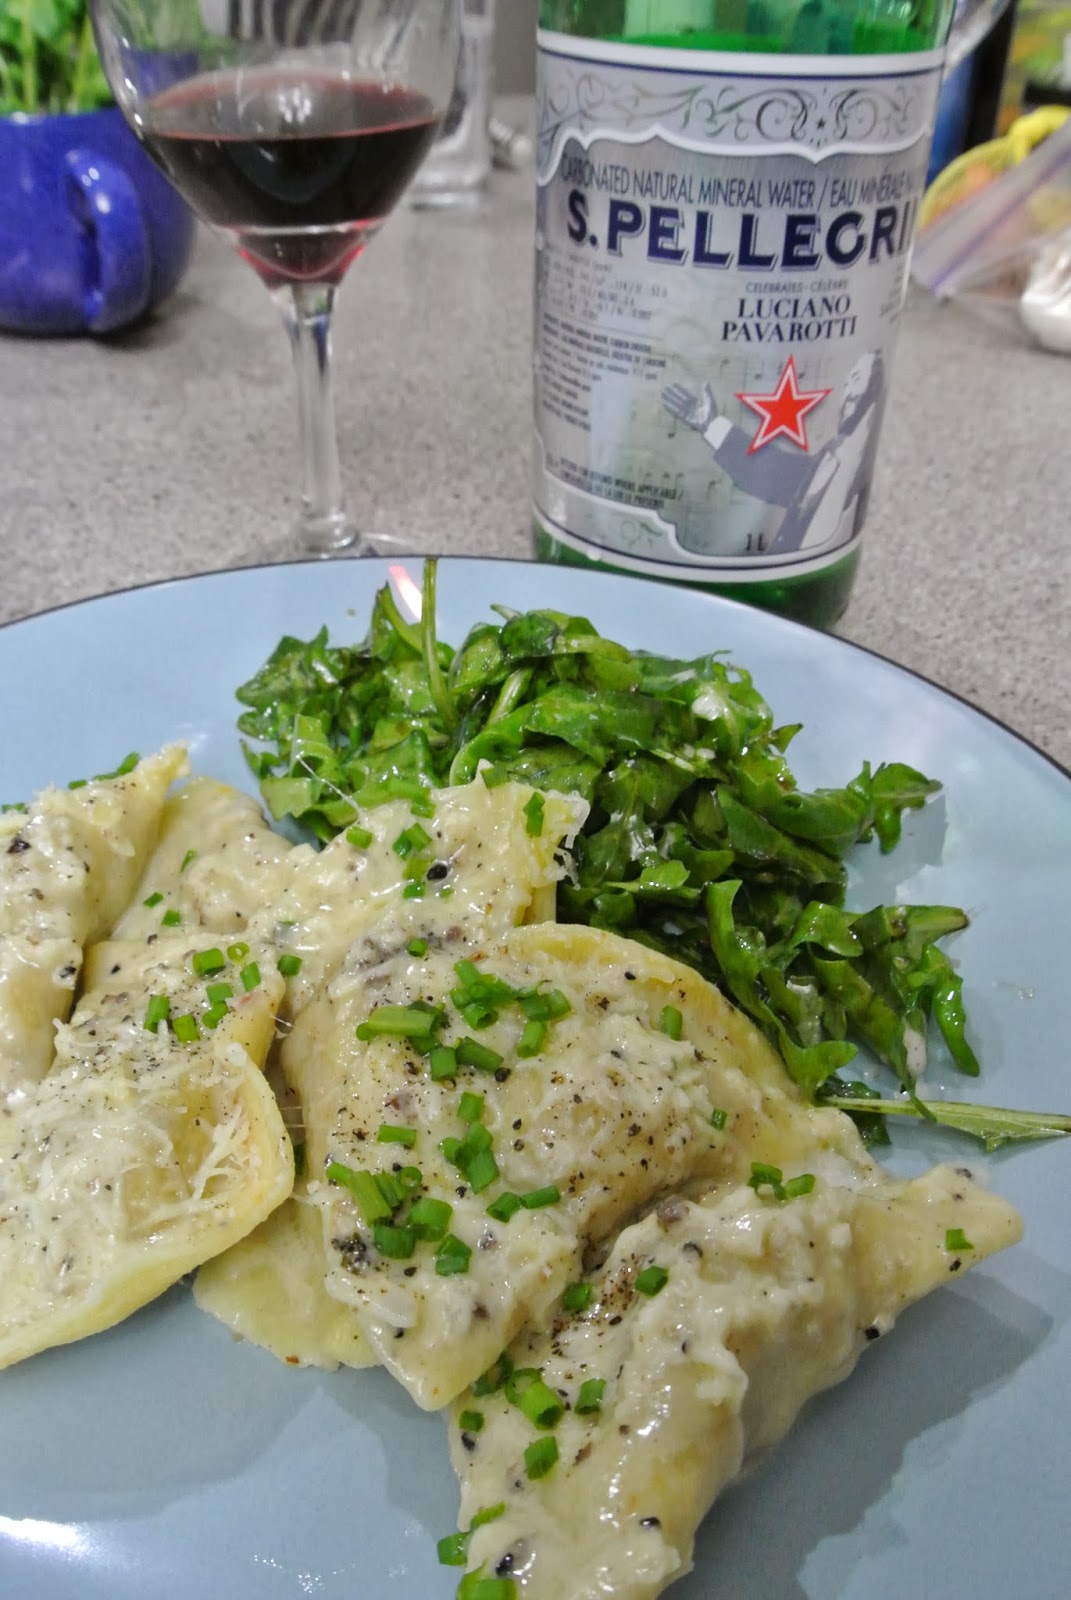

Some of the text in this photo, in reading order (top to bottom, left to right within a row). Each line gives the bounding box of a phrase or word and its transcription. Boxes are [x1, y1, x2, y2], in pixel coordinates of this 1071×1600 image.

[634, 169, 693, 203] NATURAL
[697, 176, 762, 208] MINERAL
[768, 178, 816, 209] WATER
[829, 178, 857, 208] EAU
[738, 295, 853, 319] LUCIANO
[720, 315, 857, 342] PAVAROTTI
